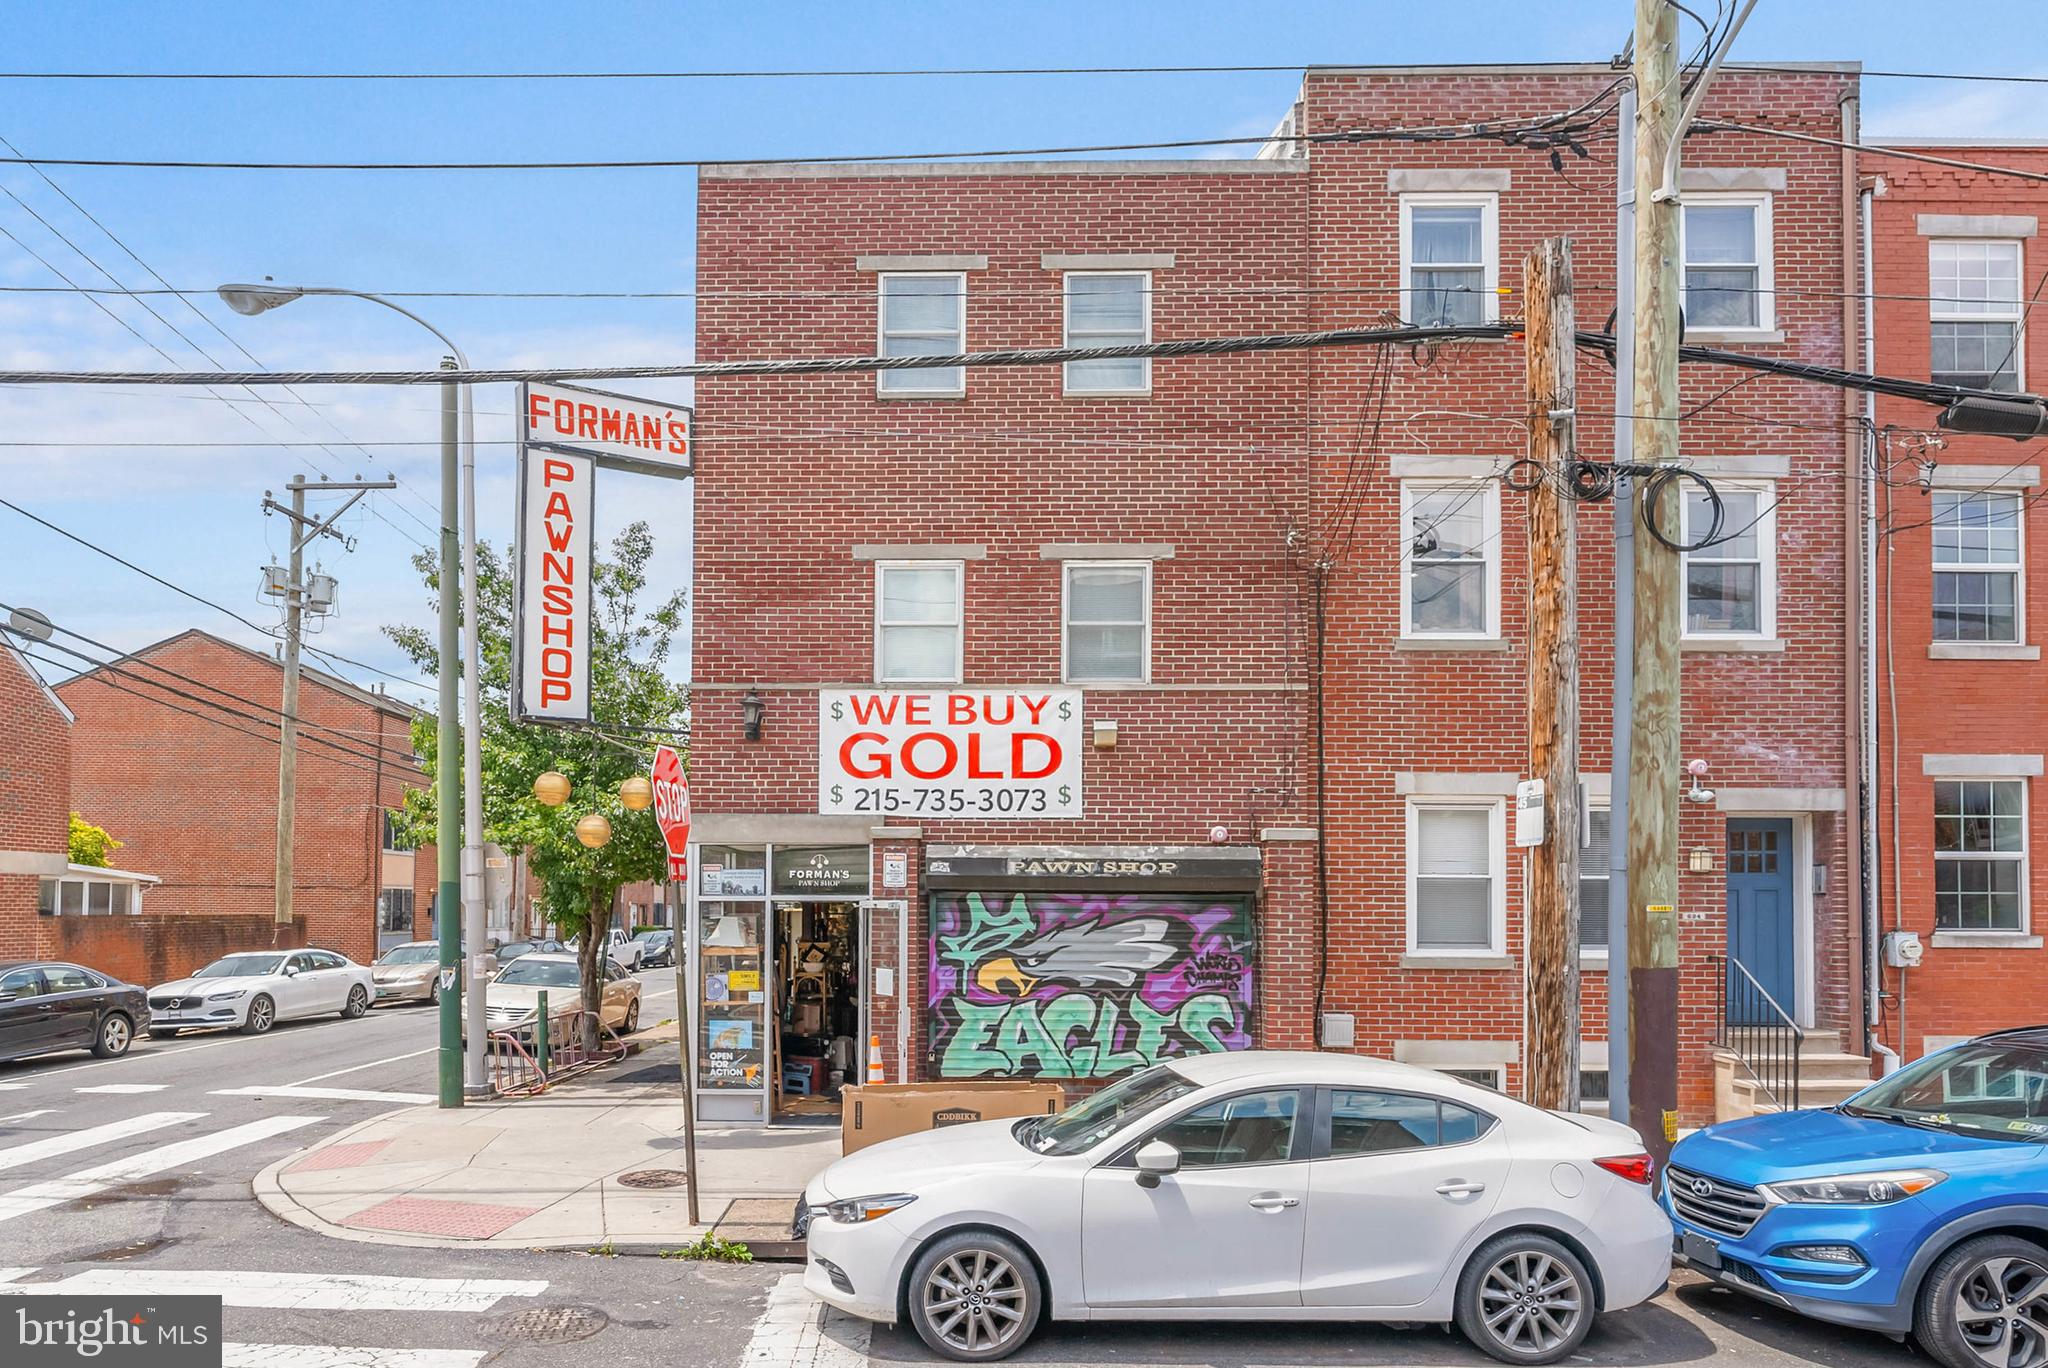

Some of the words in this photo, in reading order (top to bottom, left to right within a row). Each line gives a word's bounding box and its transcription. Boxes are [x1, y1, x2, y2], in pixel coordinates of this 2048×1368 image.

[530, 394, 687, 455] FORMAN'S
[541, 458, 575, 709] PAWNSHOP
[850, 694, 932, 725] WE
[947, 694, 1052, 726] BUY
[838, 731, 1063, 780] GOLD
[656, 778, 688, 823] STOP
[854, 788, 1047, 812] 215-735-3073
[789, 869, 850, 879] FORMAN'S
[1013, 861, 1096, 874] PAWN
[1103, 861, 1179, 874] SHOP
[940, 992, 1235, 1078] EAGLES
[710, 1052, 733, 1060] OPEN
[711, 1060, 729, 1068] FOR
[710, 1068, 743, 1076] ACTION
[936, 1112, 977, 1121] CDDBIKK
